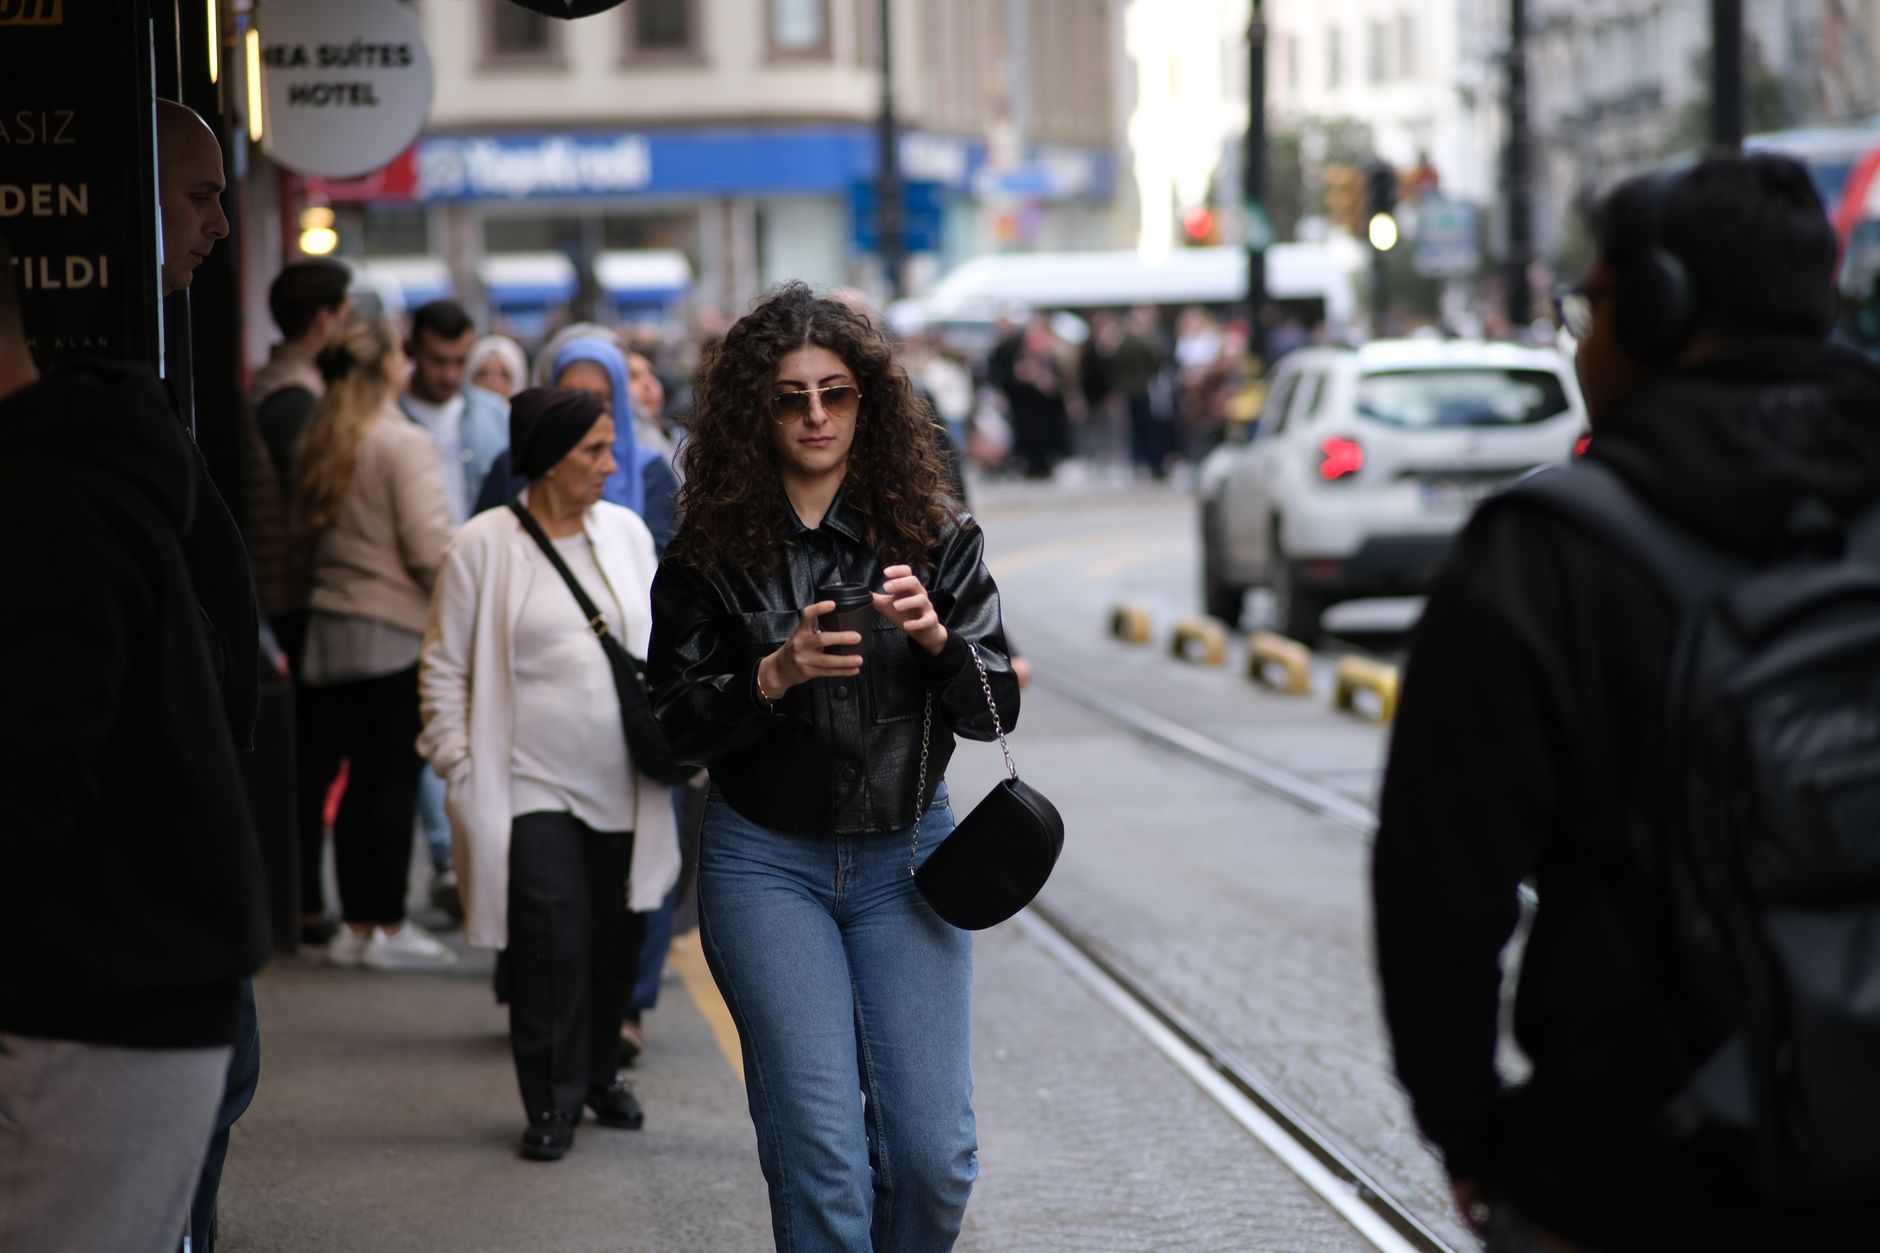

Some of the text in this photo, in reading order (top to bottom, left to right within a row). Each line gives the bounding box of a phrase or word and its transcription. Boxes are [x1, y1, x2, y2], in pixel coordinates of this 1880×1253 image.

[289, 83, 378, 105] HOTEL
[0, 182, 89, 217] DEN
[9, 255, 109, 290] ILDI
